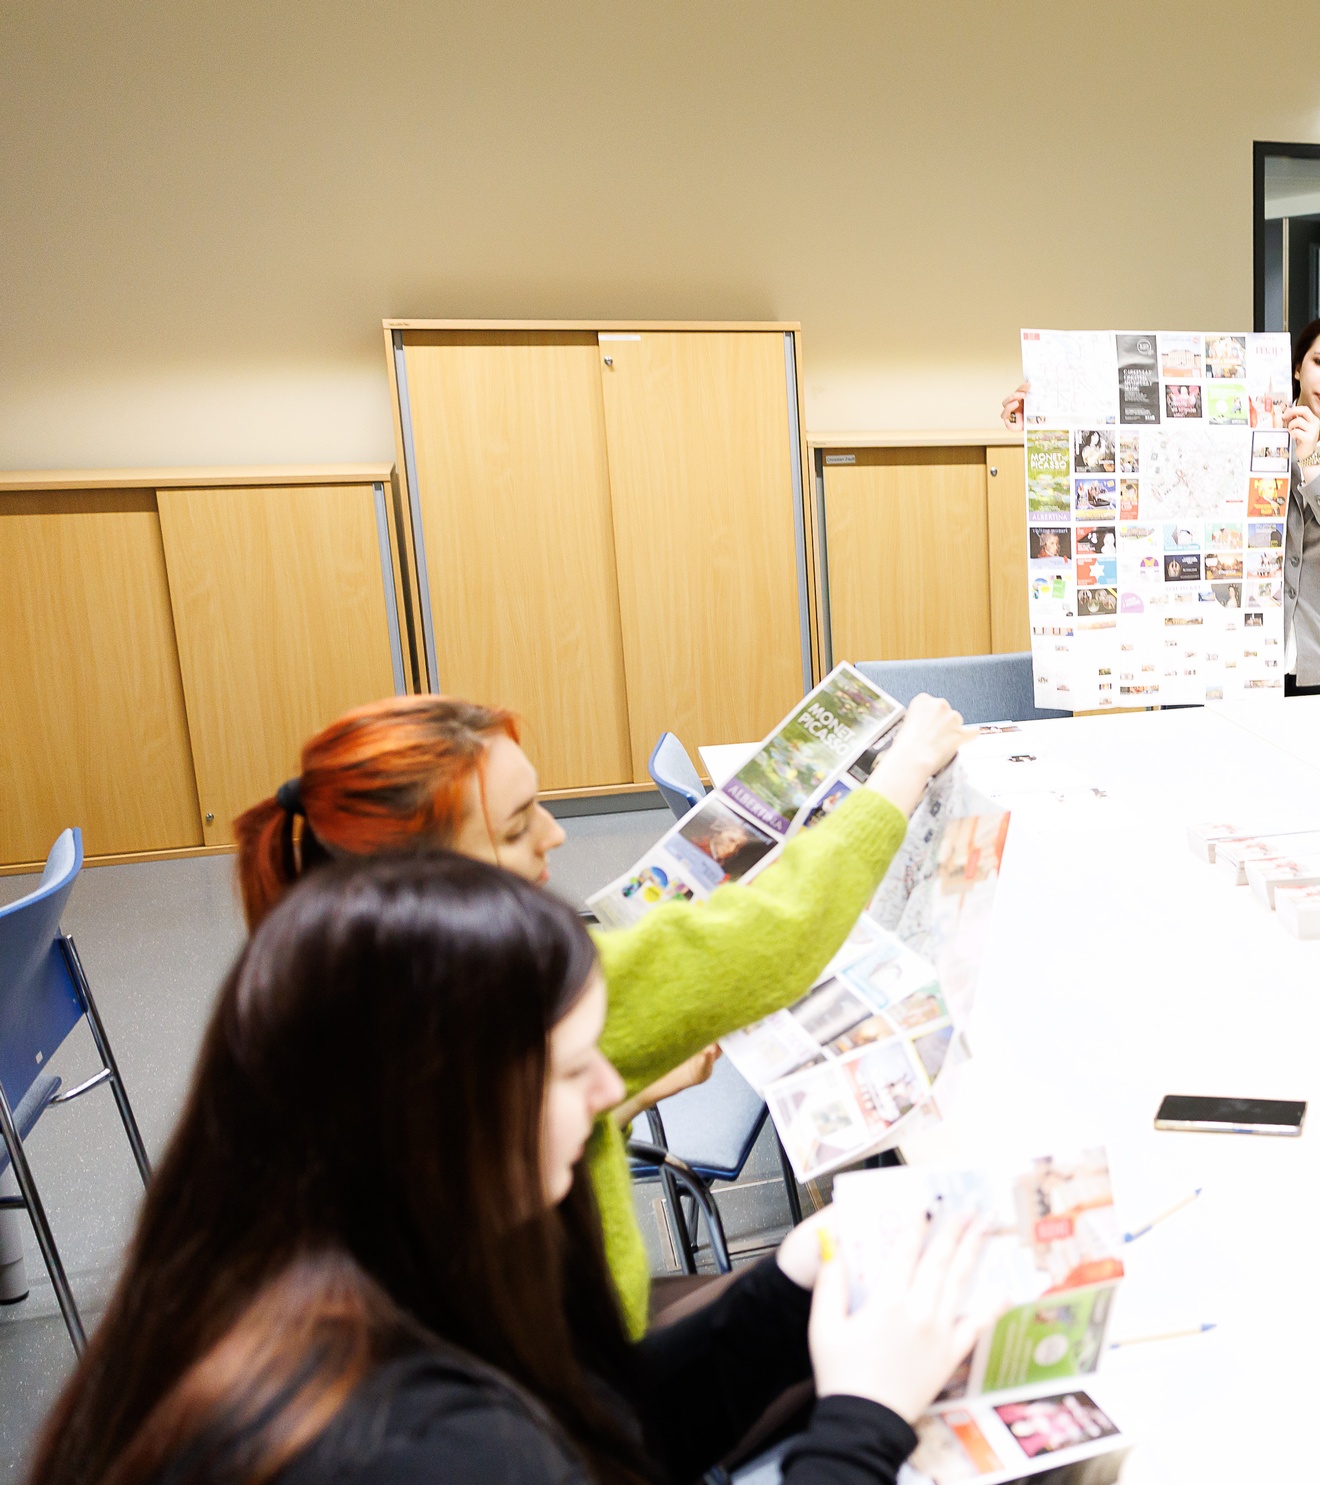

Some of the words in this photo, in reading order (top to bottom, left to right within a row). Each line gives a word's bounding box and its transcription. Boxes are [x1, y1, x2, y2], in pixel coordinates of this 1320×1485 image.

[1030, 460, 1067, 470] PICASSO
[1031, 452, 1062, 462] MONET
[797, 712, 850, 756] PICASSO
[807, 702, 857, 741] MONET
[727, 785, 784, 831] ALBERTINA
